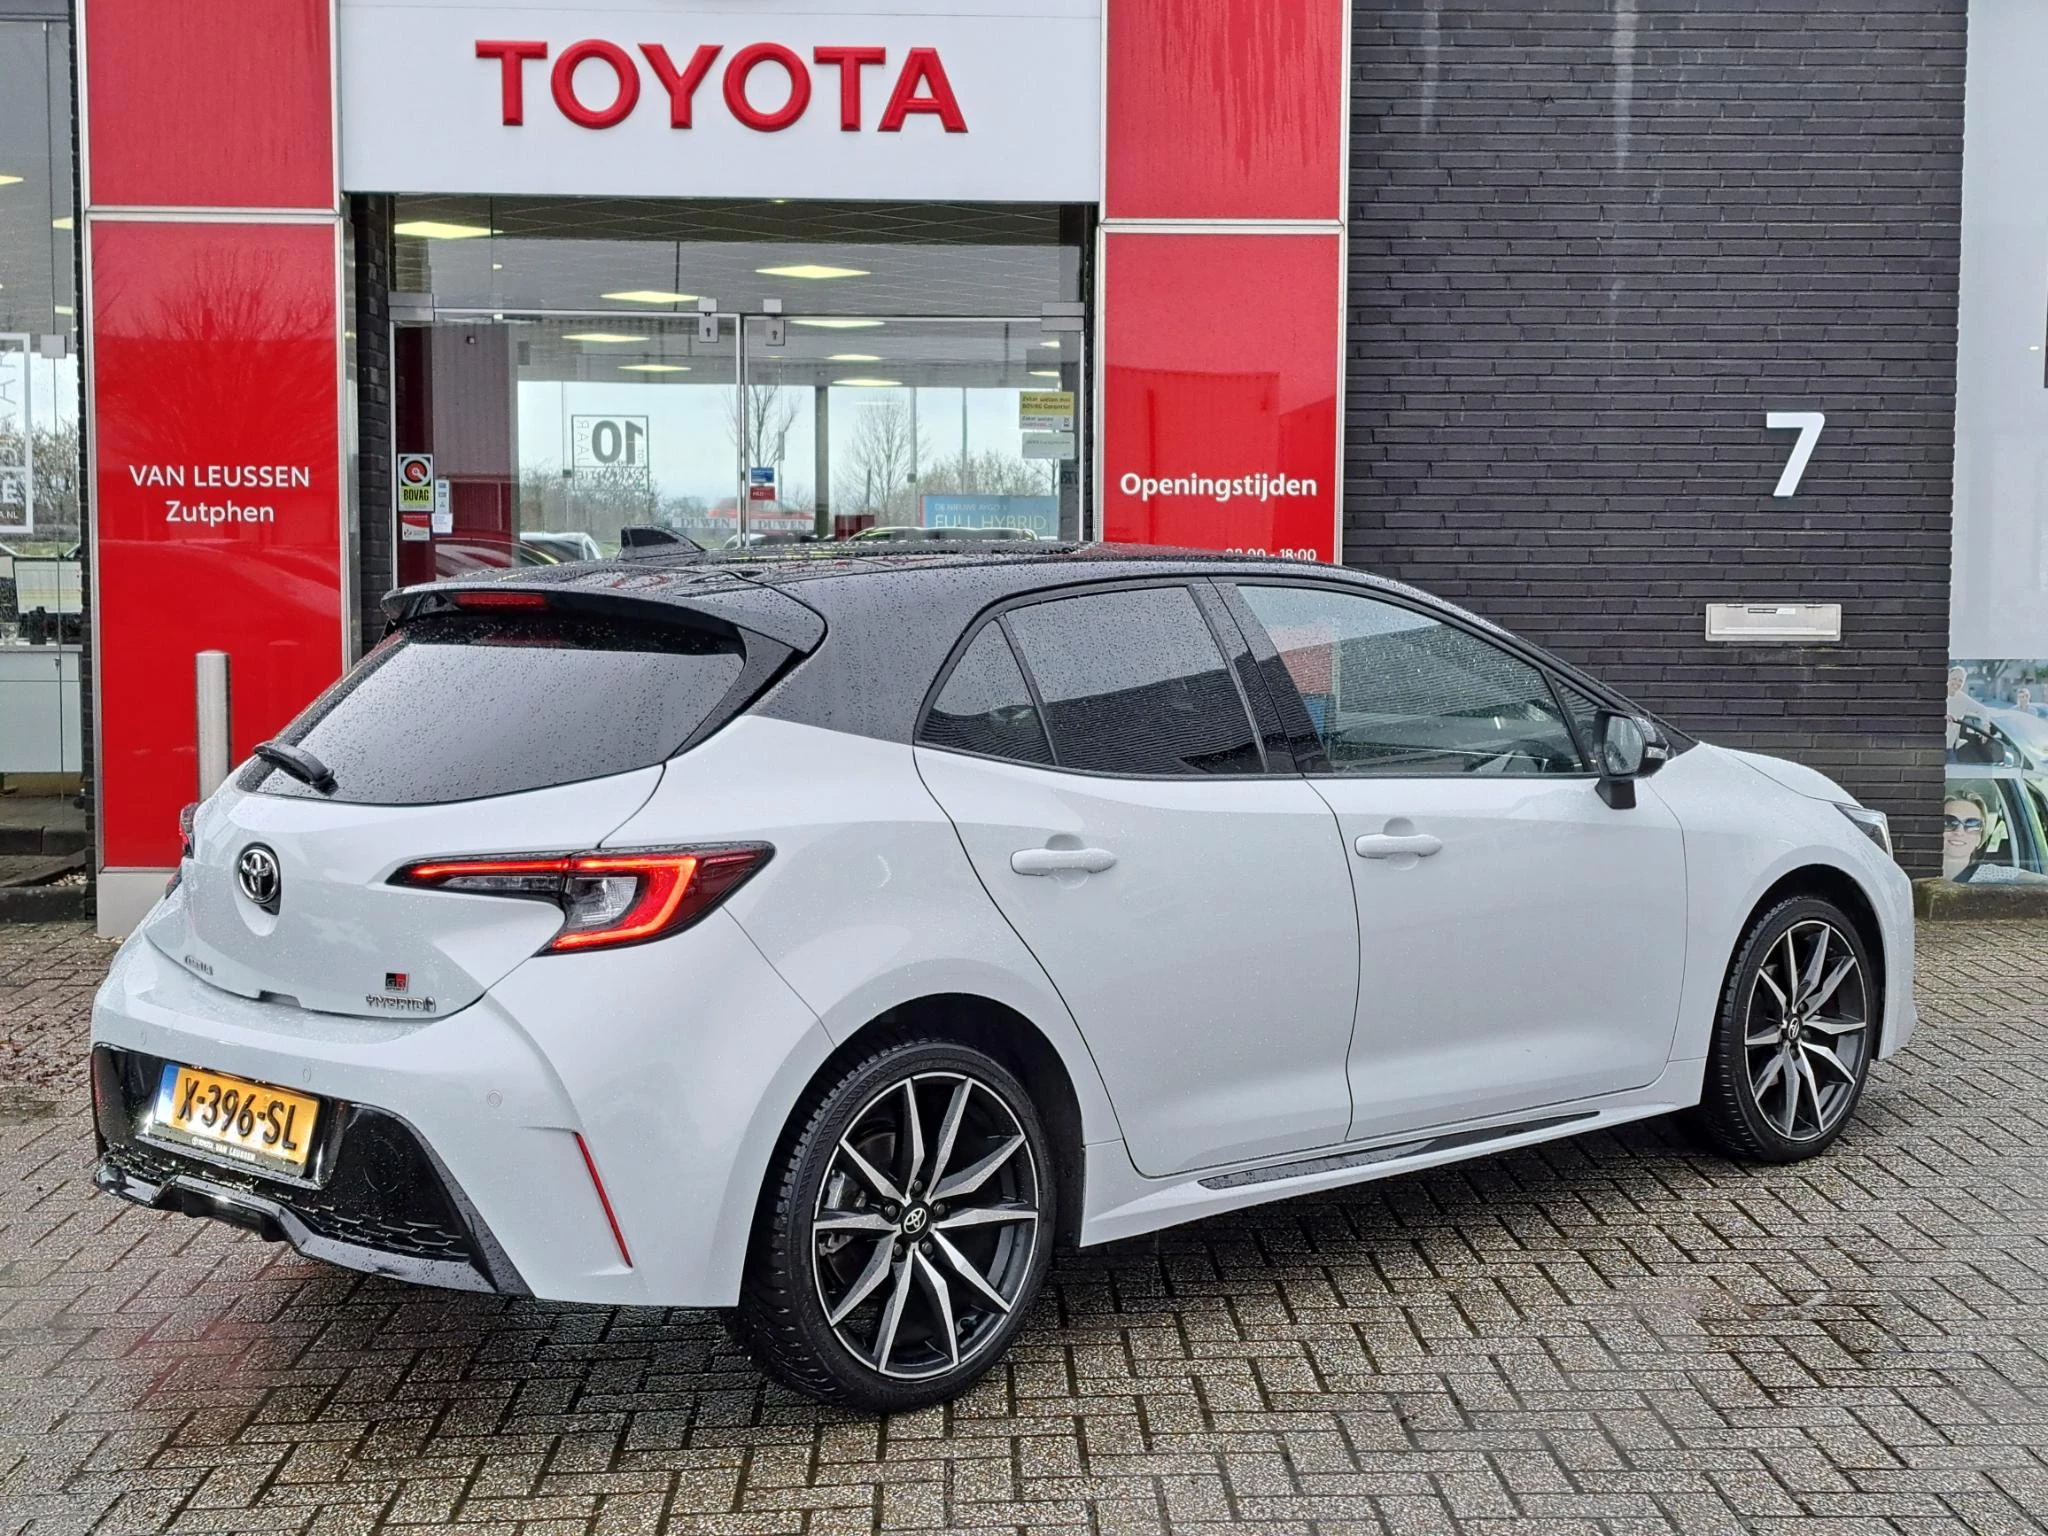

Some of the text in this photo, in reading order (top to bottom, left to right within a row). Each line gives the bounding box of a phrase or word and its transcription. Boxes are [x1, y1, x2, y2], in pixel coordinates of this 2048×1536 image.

[475, 38, 969, 133] TOYOTA
[1766, 412, 1825, 497] 7
[129, 465, 310, 488] VAN LEUSSEN
[1120, 473, 1318, 502] Openingstijden
[403, 488, 429, 501] BOVAG
[165, 500, 274, 527] Zutphen
[982, 514, 1047, 530] HYBRID
[177, 1077, 297, 1150] X-396-SL
